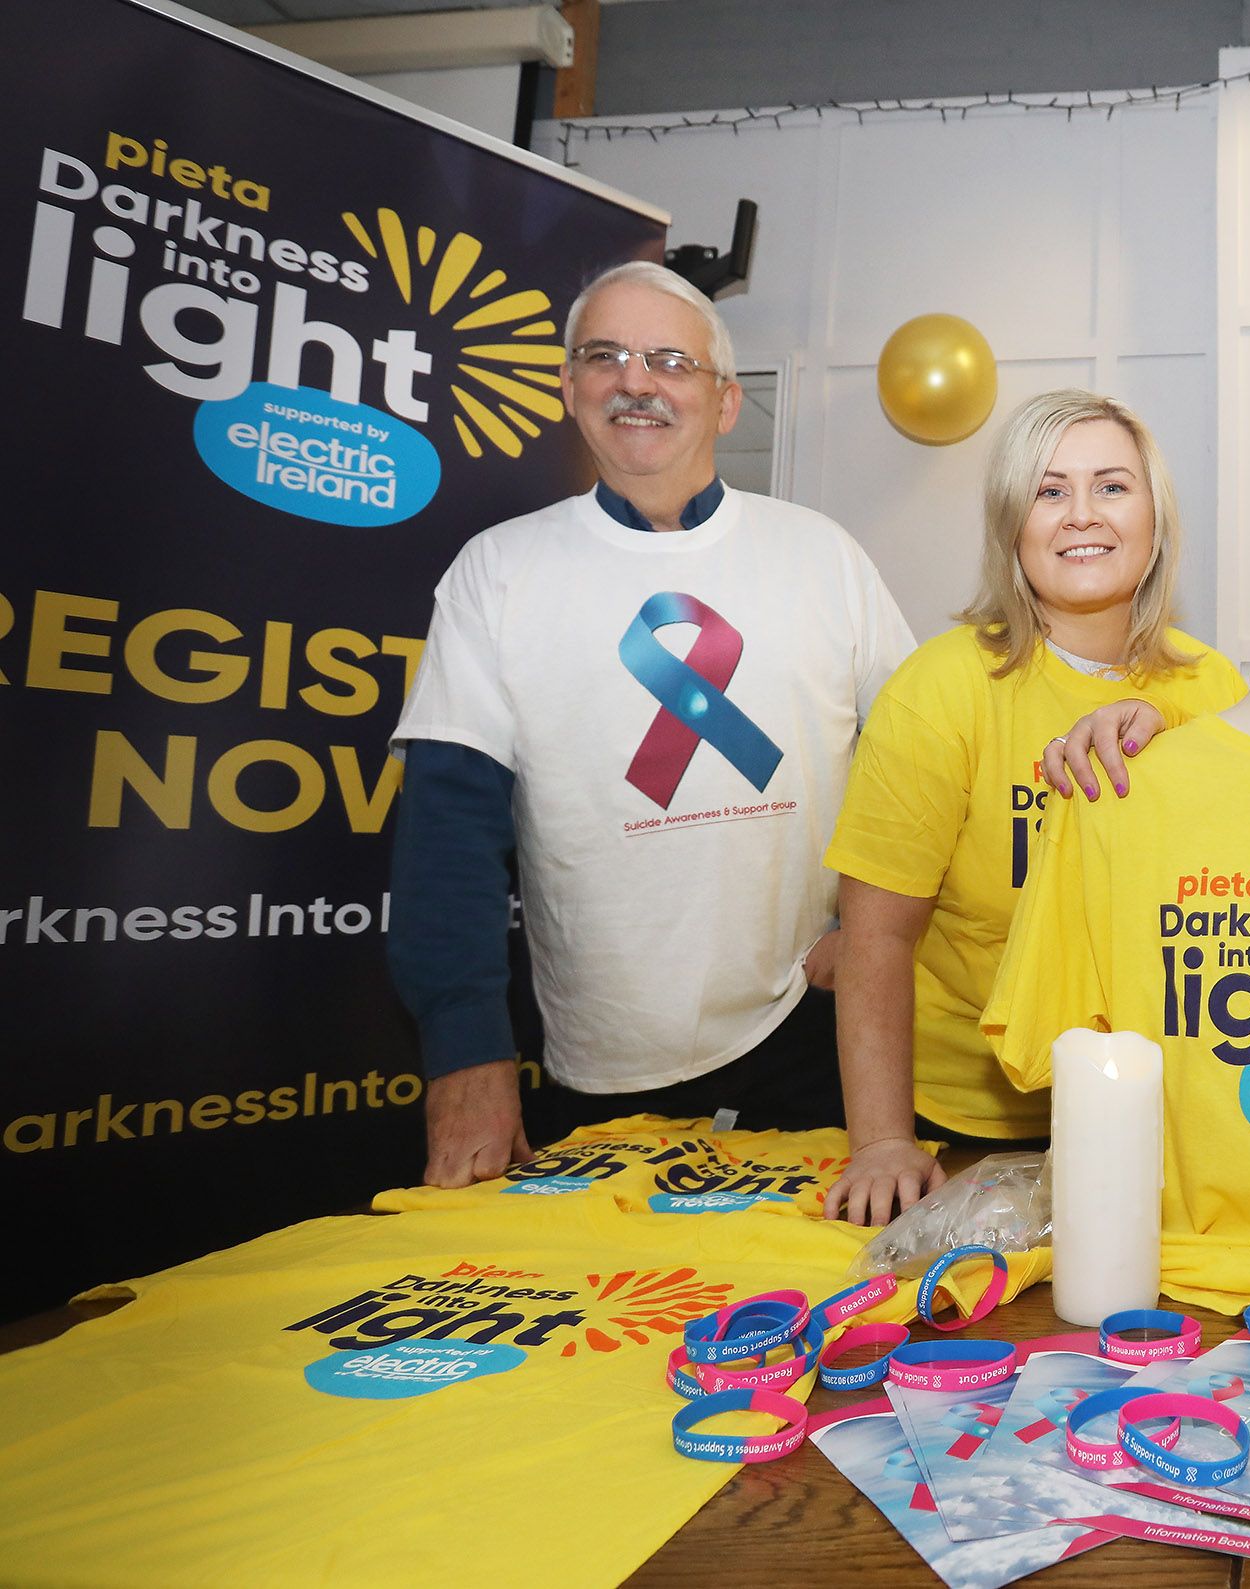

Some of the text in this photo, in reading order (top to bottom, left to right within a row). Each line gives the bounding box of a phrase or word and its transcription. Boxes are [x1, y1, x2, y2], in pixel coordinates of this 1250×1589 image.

[104, 131, 271, 213] pieta
[39, 147, 371, 294] Darkness
[162, 240, 262, 294] into
[22, 201, 433, 424] light
[263, 401, 390, 443] supported by
[226, 421, 396, 479] electric
[255, 450, 396, 510] Ireland
[624, 799, 797, 832] Suicide Awareness & Support Group
[382, 1274, 579, 1301] Darkness
[919, 1278, 932, 1309] Support
[928, 1259, 945, 1278] Group
[416, 1293, 481, 1309] into
[840, 1287, 882, 1315] Reach Out
[281, 1289, 587, 1351] light
[749, 1329, 782, 1351] Support
[783, 1329, 790, 1340] &
[722, 1345, 749, 1357] Group
[1110, 1345, 1146, 1358] Awareness
[1149, 1345, 1174, 1357] Suicide
[342, 1352, 477, 1381] electric
[761, 1366, 793, 1383] Reach
[958, 1365, 1008, 1385] Reach Out
[904, 1373, 929, 1386] Suicide
[693, 1441, 725, 1457] Support
[726, 1445, 734, 1457] &
[735, 1440, 784, 1455] Awareness
[1078, 1449, 1107, 1465] Suicide
[1124, 1432, 1130, 1445] &
[1129, 1439, 1156, 1464] Support
[1155, 1457, 1181, 1478] Group
[1172, 1493, 1238, 1514] Information
[1144, 1525, 1217, 1544] Information
